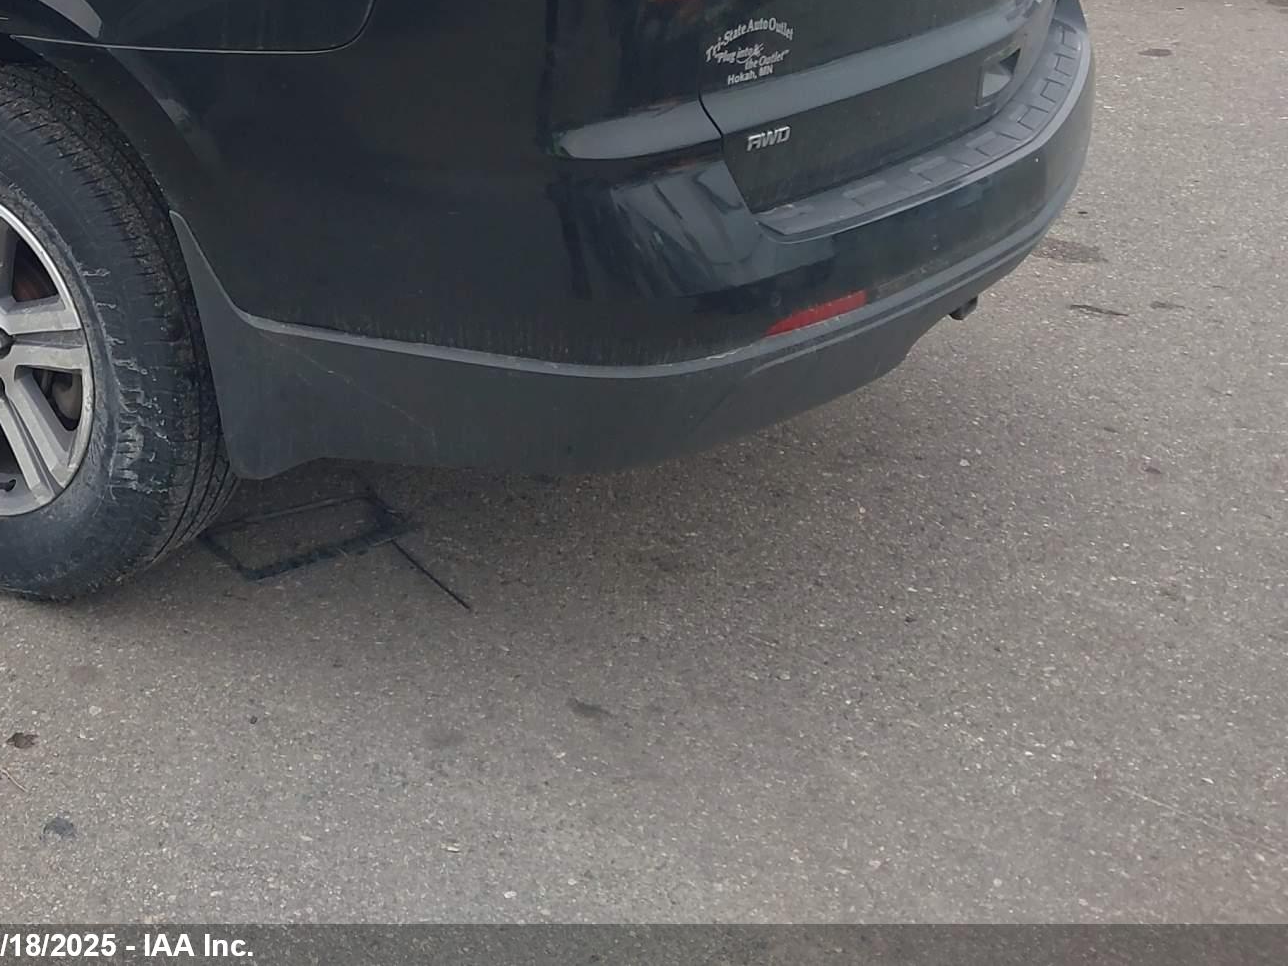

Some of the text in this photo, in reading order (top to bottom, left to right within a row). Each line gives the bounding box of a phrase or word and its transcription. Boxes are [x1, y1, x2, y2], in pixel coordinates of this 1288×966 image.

[705, 17, 794, 62] Tri-State Auto Outlet
[727, 64, 774, 86] Hokah, MN
[745, 58, 758, 70] the
[746, 126, 791, 152] AWD
